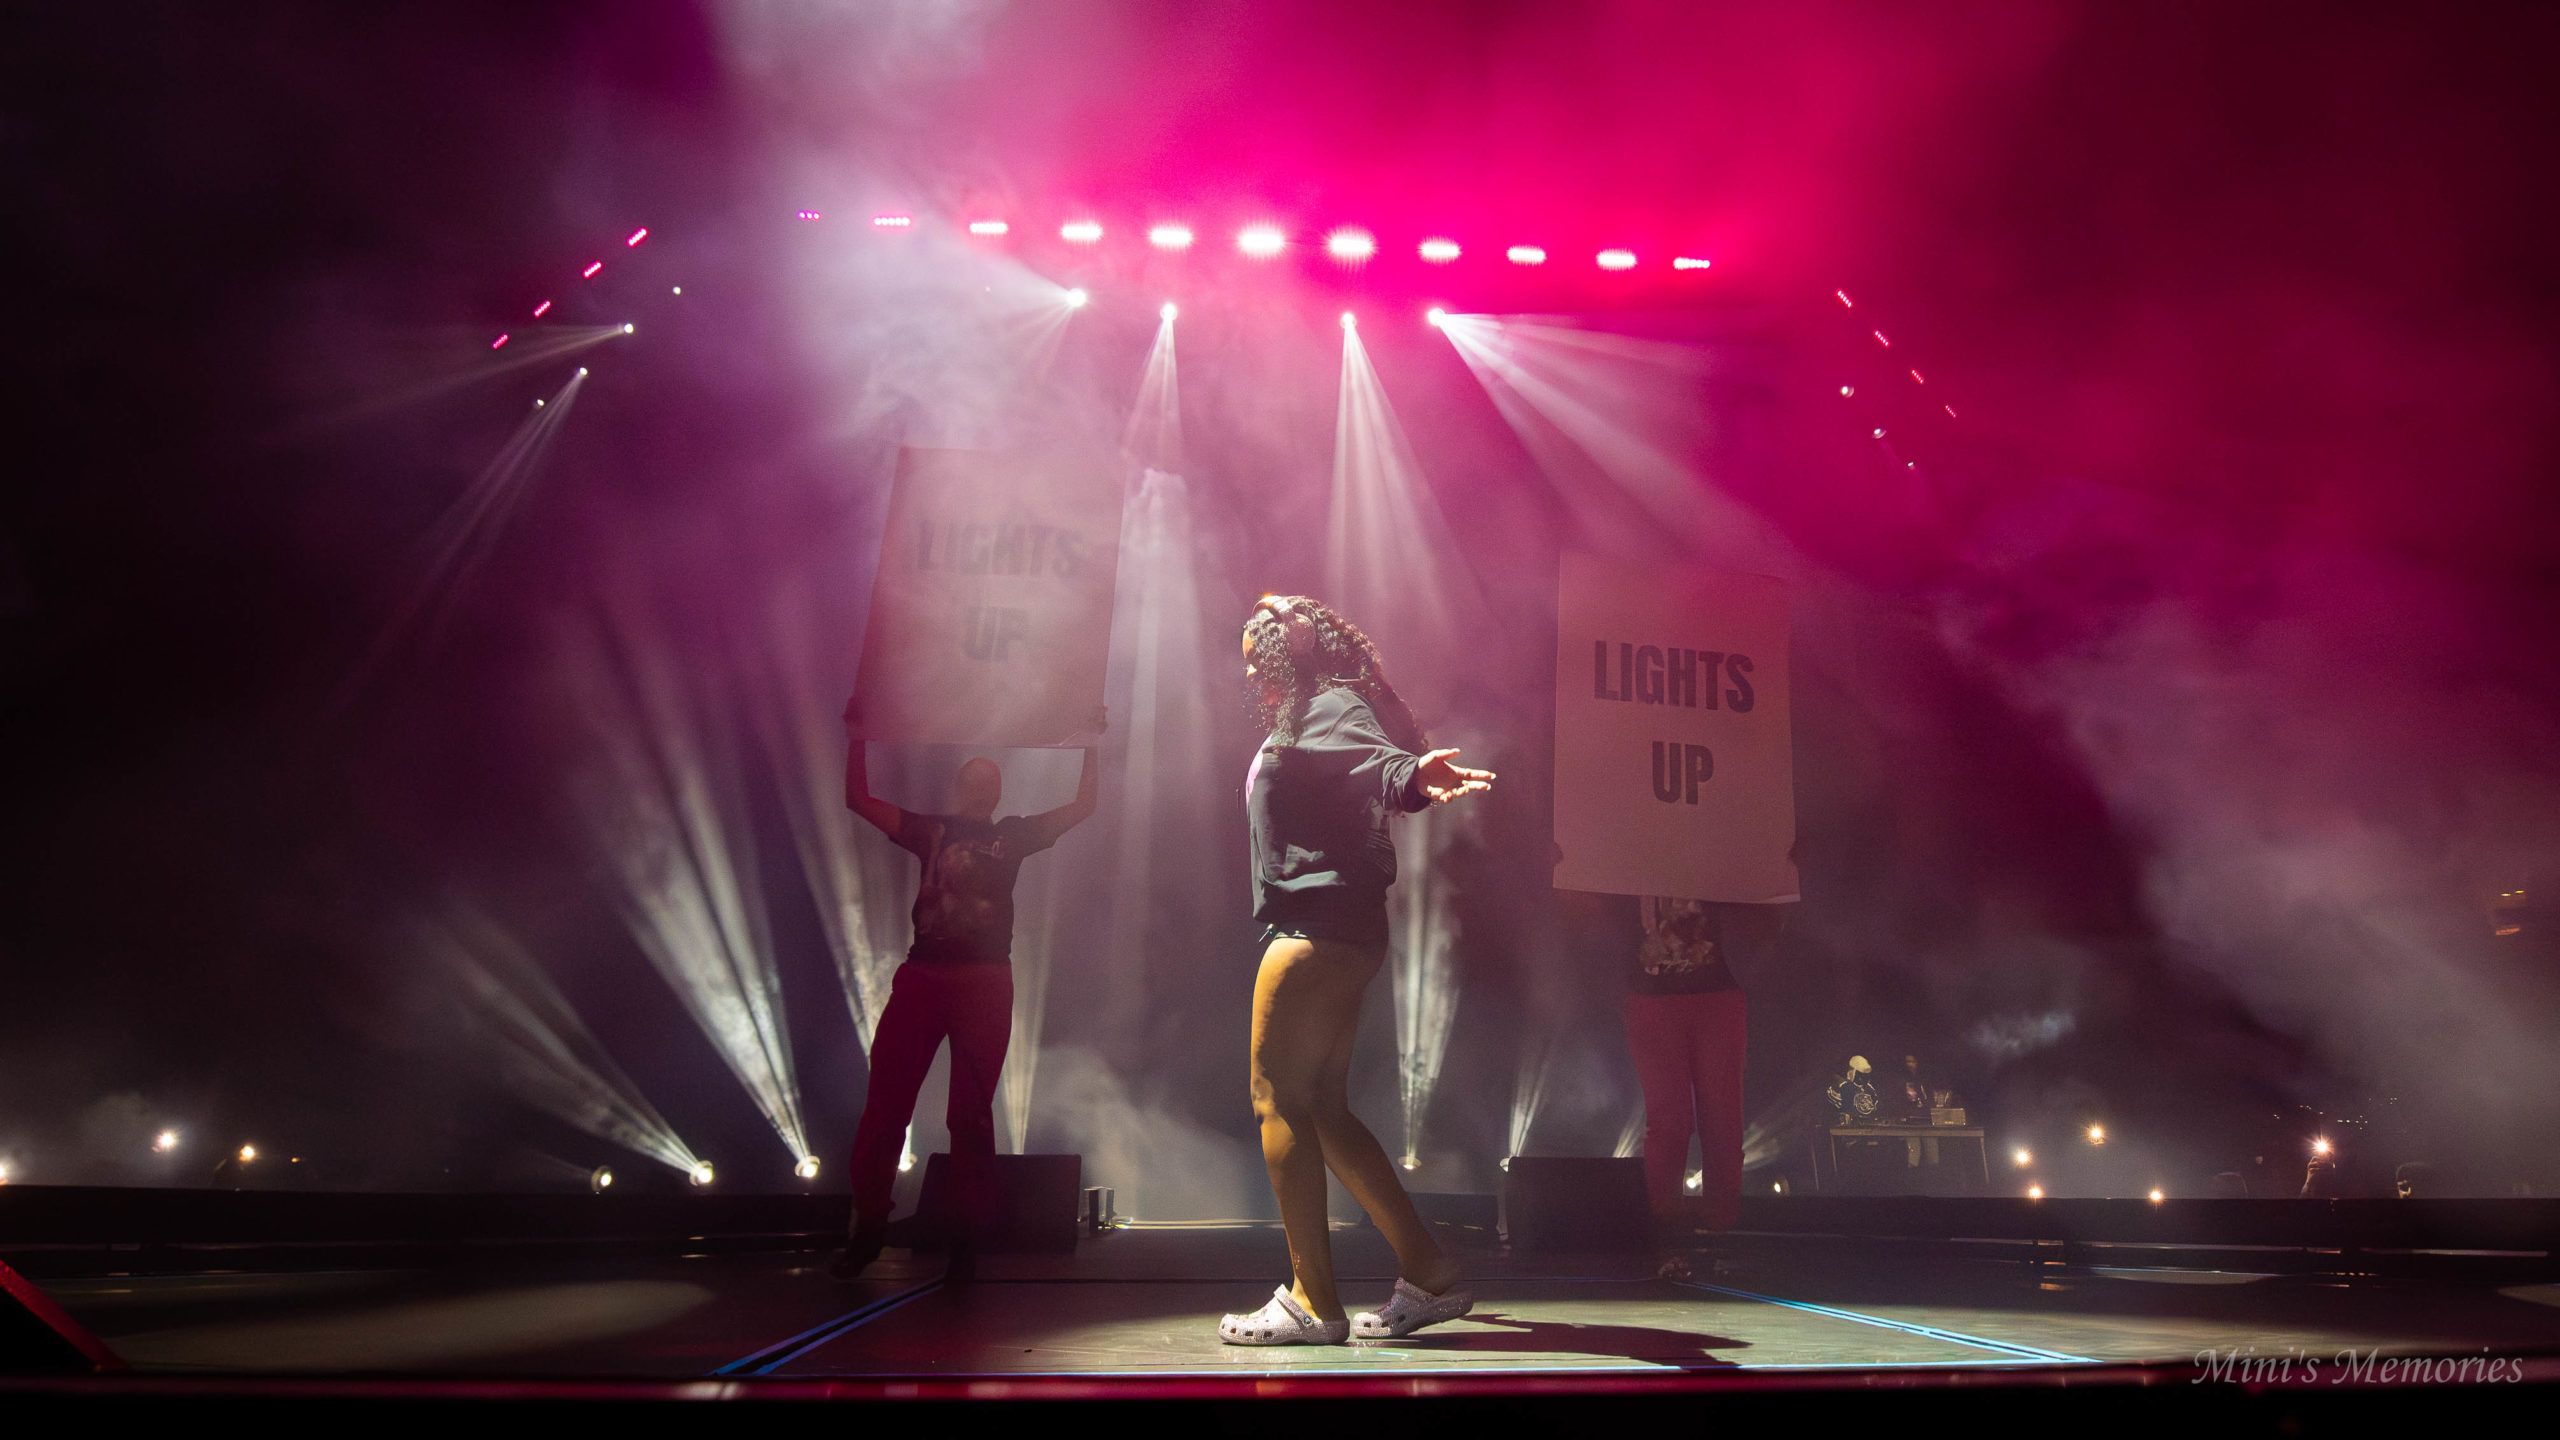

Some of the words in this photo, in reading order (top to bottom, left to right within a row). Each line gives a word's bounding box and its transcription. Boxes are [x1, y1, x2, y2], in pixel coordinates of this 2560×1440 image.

[917, 520, 1086, 578] LIGHTS
[963, 607, 1028, 662] UP
[1594, 640, 1755, 713] LIGHTS
[1652, 741, 1714, 804] UP
